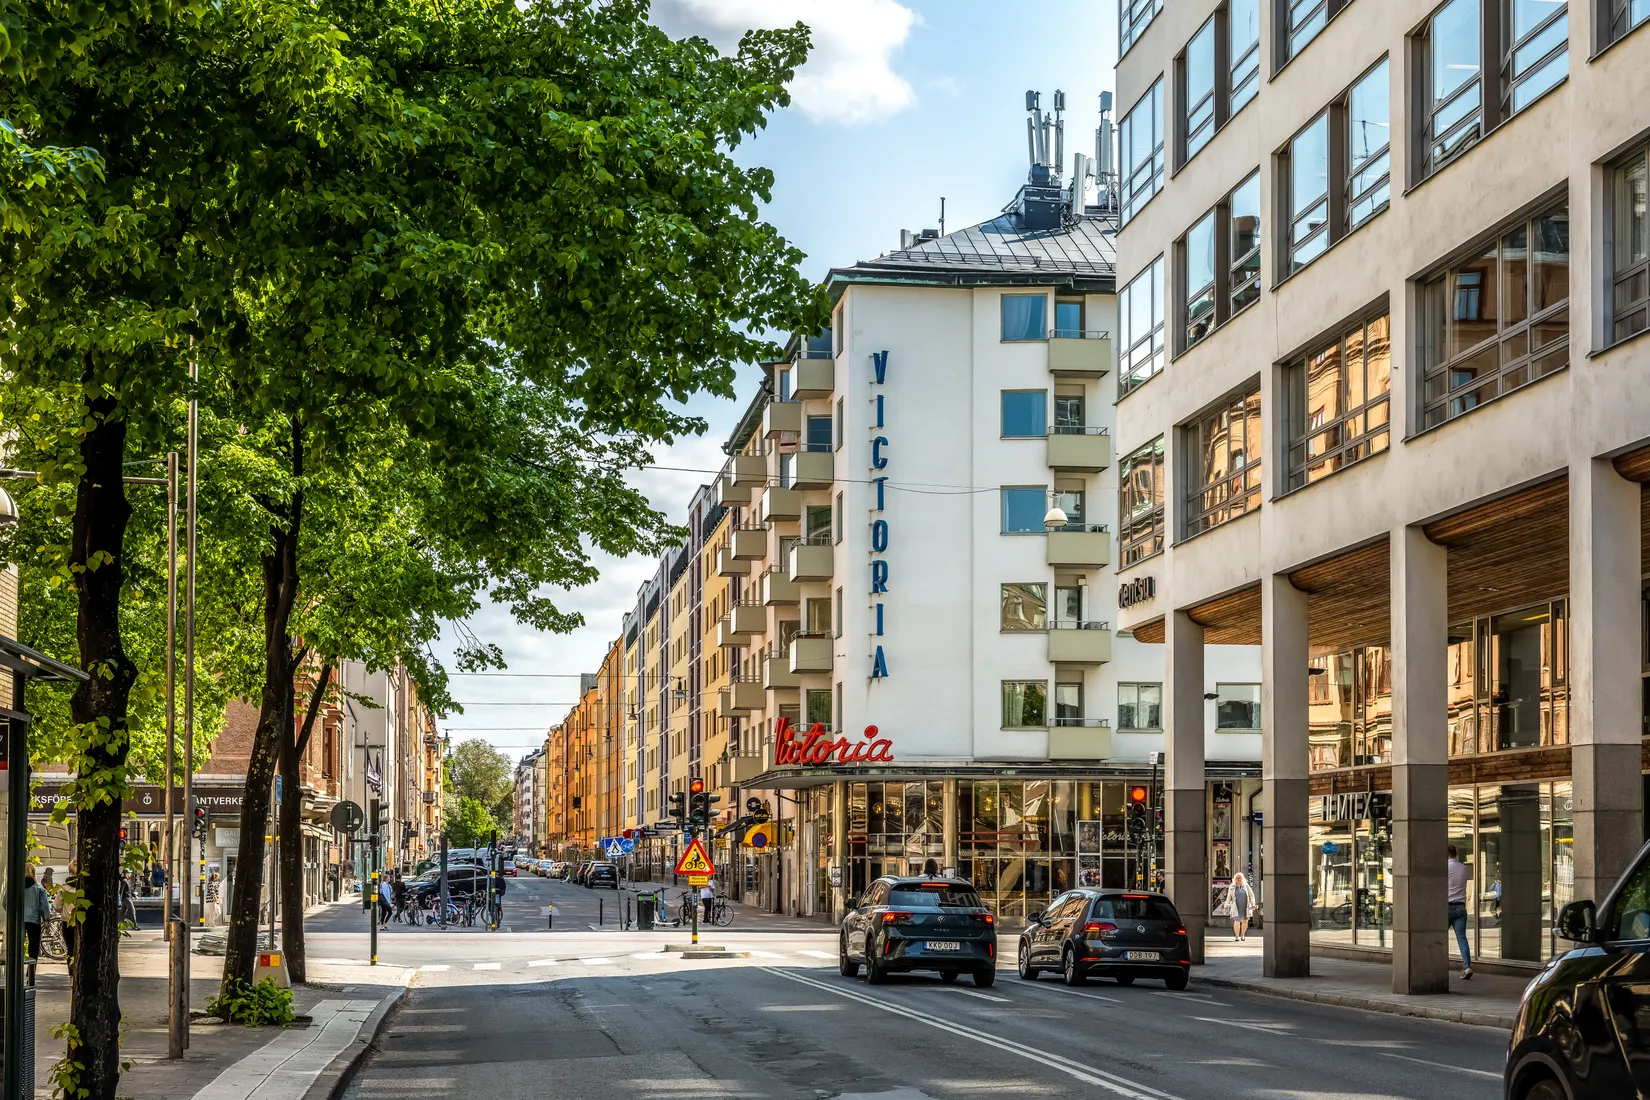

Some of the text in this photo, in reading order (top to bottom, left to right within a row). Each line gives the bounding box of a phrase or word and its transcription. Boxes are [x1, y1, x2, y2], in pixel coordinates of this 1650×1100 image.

[872, 350, 889, 679] VICTORIA
[1118, 576, 1156, 609] dentsu
[774, 717, 894, 765] Victoria
[195, 796, 244, 805] ANTVERKE
[1321, 791, 1372, 821] HEMTEX
